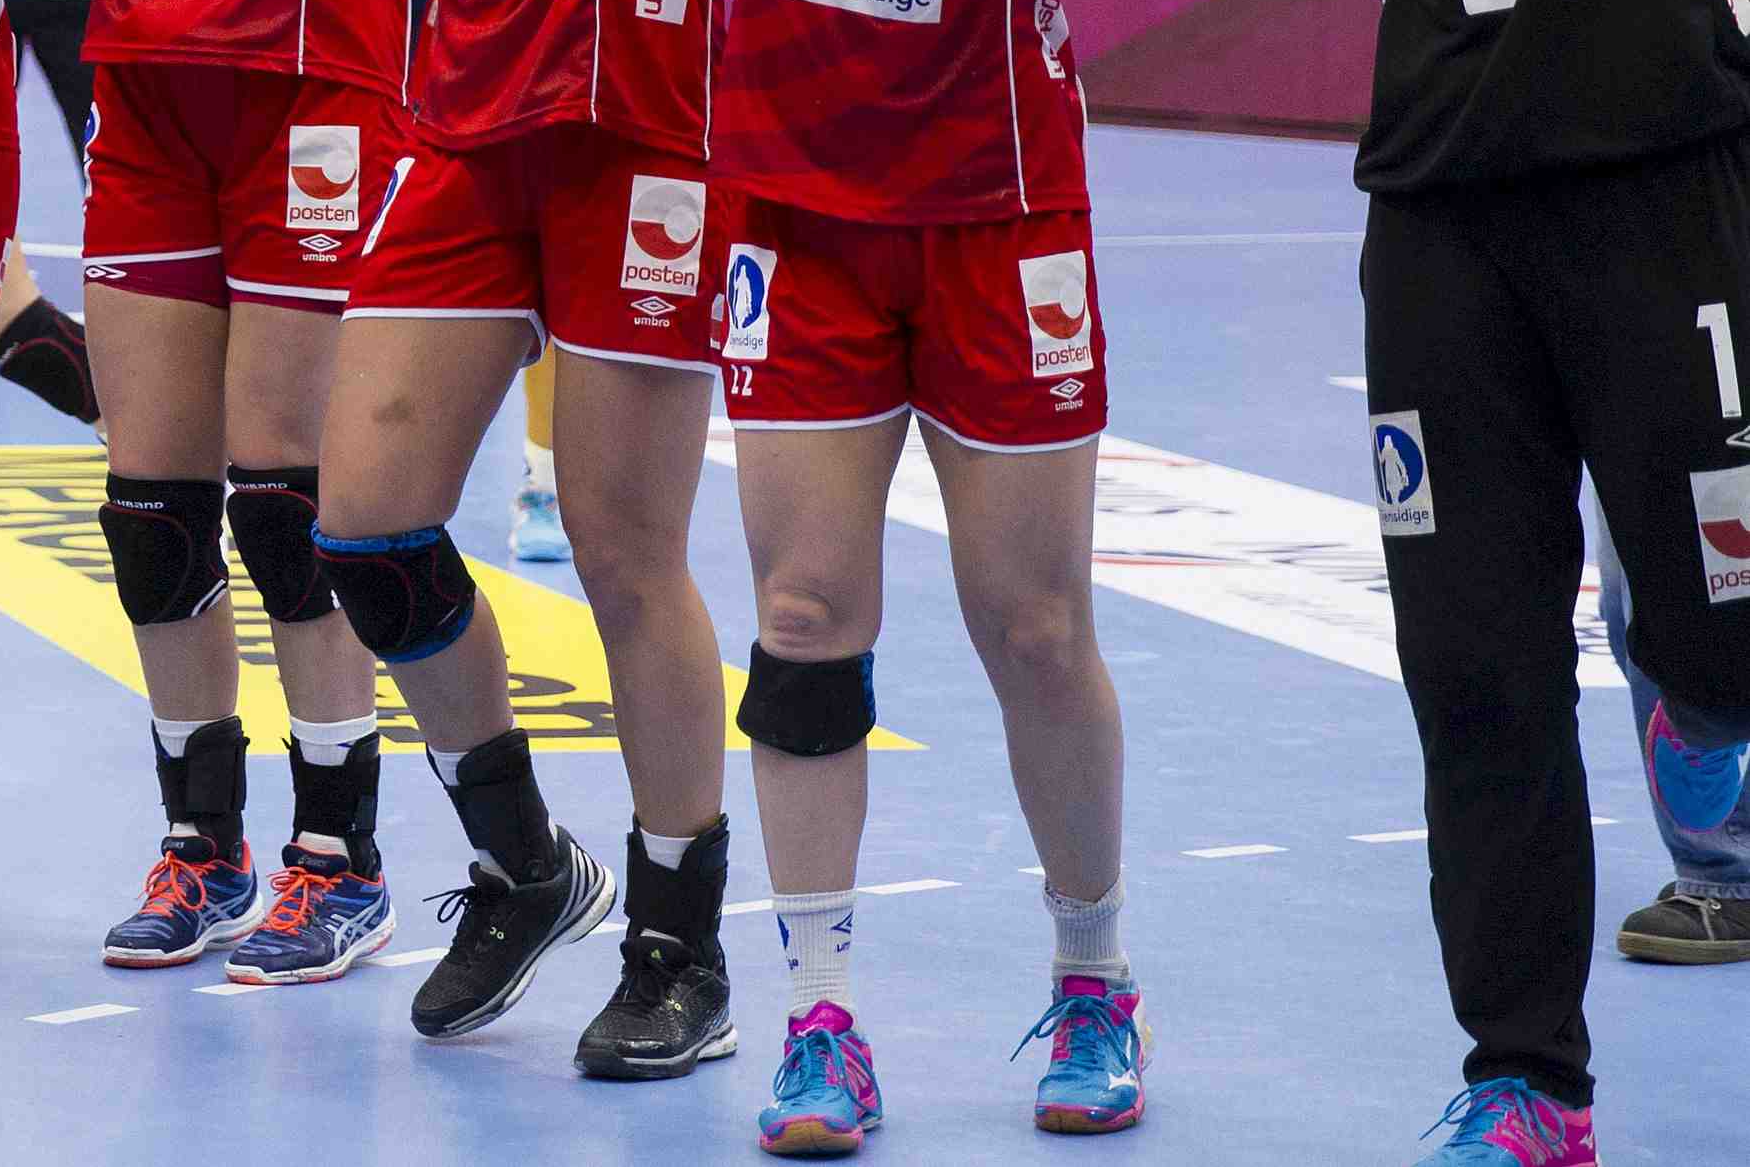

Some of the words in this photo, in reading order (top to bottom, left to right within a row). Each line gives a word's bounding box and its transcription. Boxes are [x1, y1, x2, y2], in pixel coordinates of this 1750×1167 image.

[289, 204, 356, 224] posten
[302, 252, 338, 263] umbro
[625, 264, 696, 287] posten
[633, 315, 671, 328] umbro
[1035, 345, 1090, 370] posten
[1054, 398, 1084, 412] umbro
[1709, 569, 1750, 596] pos
